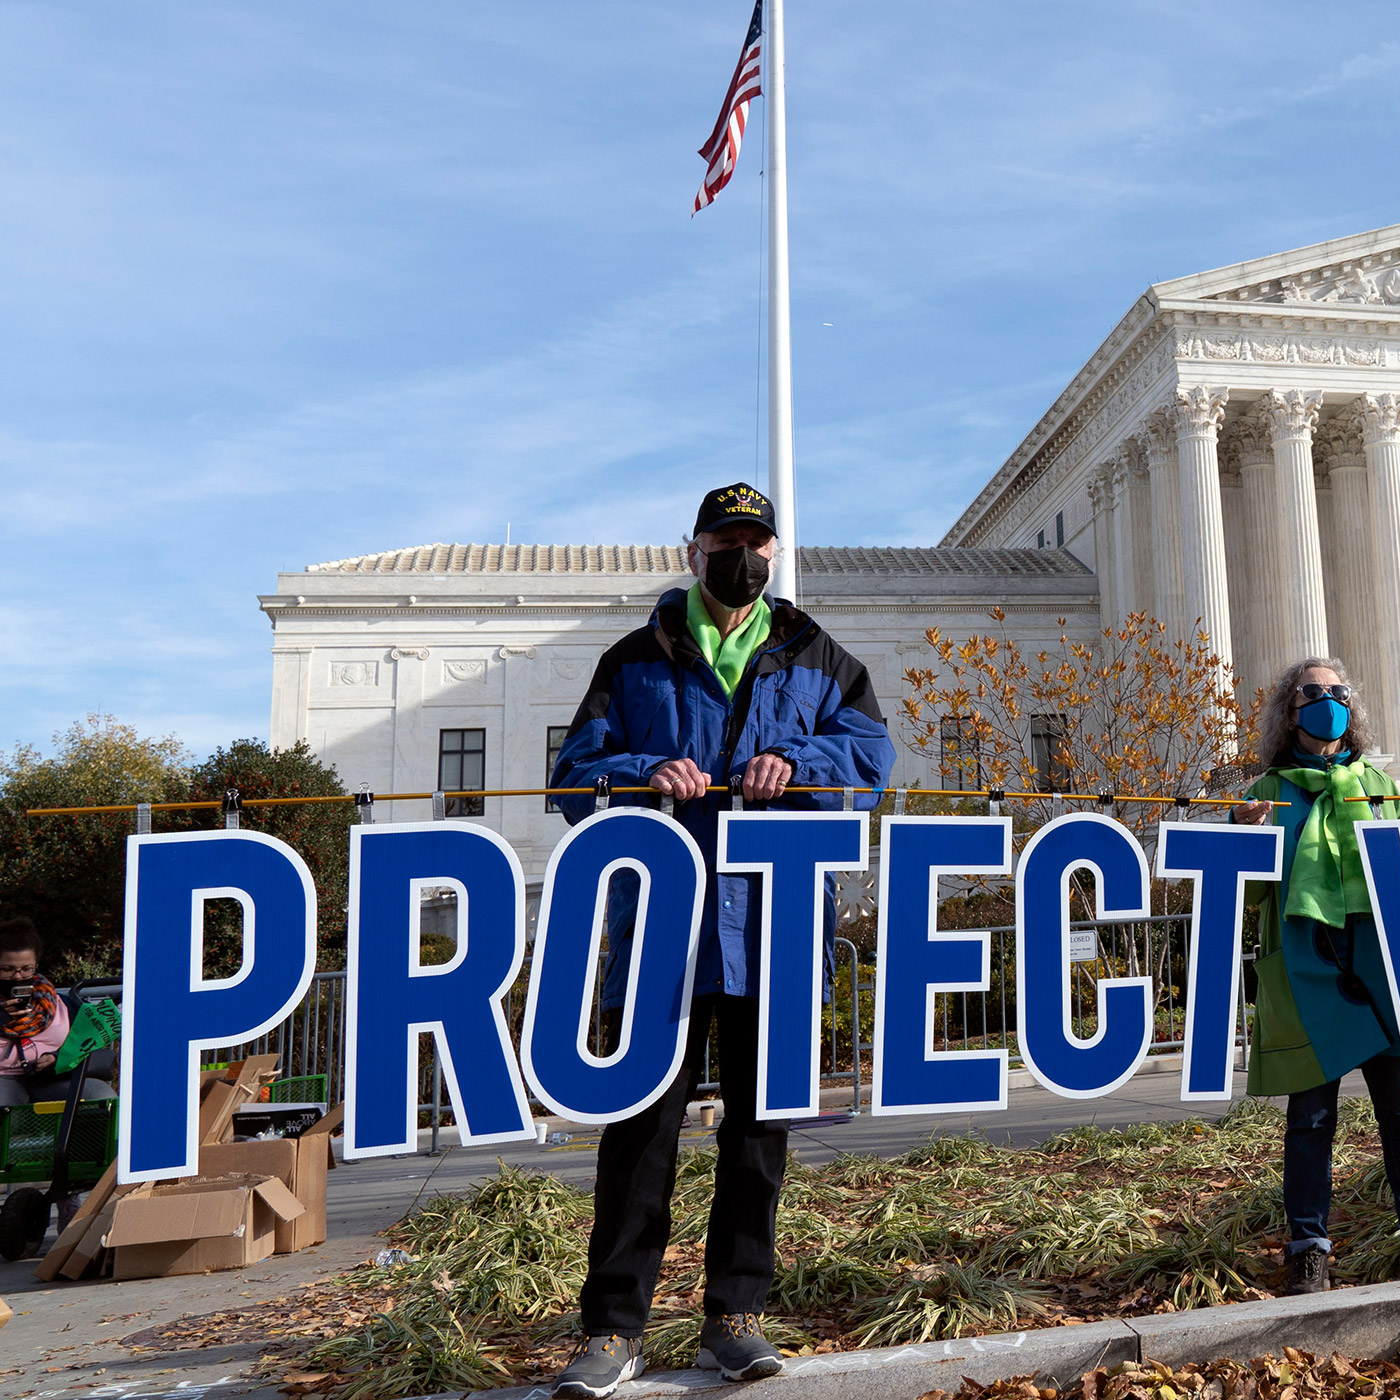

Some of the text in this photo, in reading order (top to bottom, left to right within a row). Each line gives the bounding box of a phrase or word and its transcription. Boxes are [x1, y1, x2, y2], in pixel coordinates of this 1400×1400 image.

[717, 487, 768, 505] U.S. NAVY
[725, 506, 761, 516] VETERAN
[117, 806, 1285, 1184] PROTECT
[84, 1007, 111, 1046] FOR ABORTION
[286, 1125, 302, 1133] ALL
[791, 1332, 1028, 1374] AGAIN
